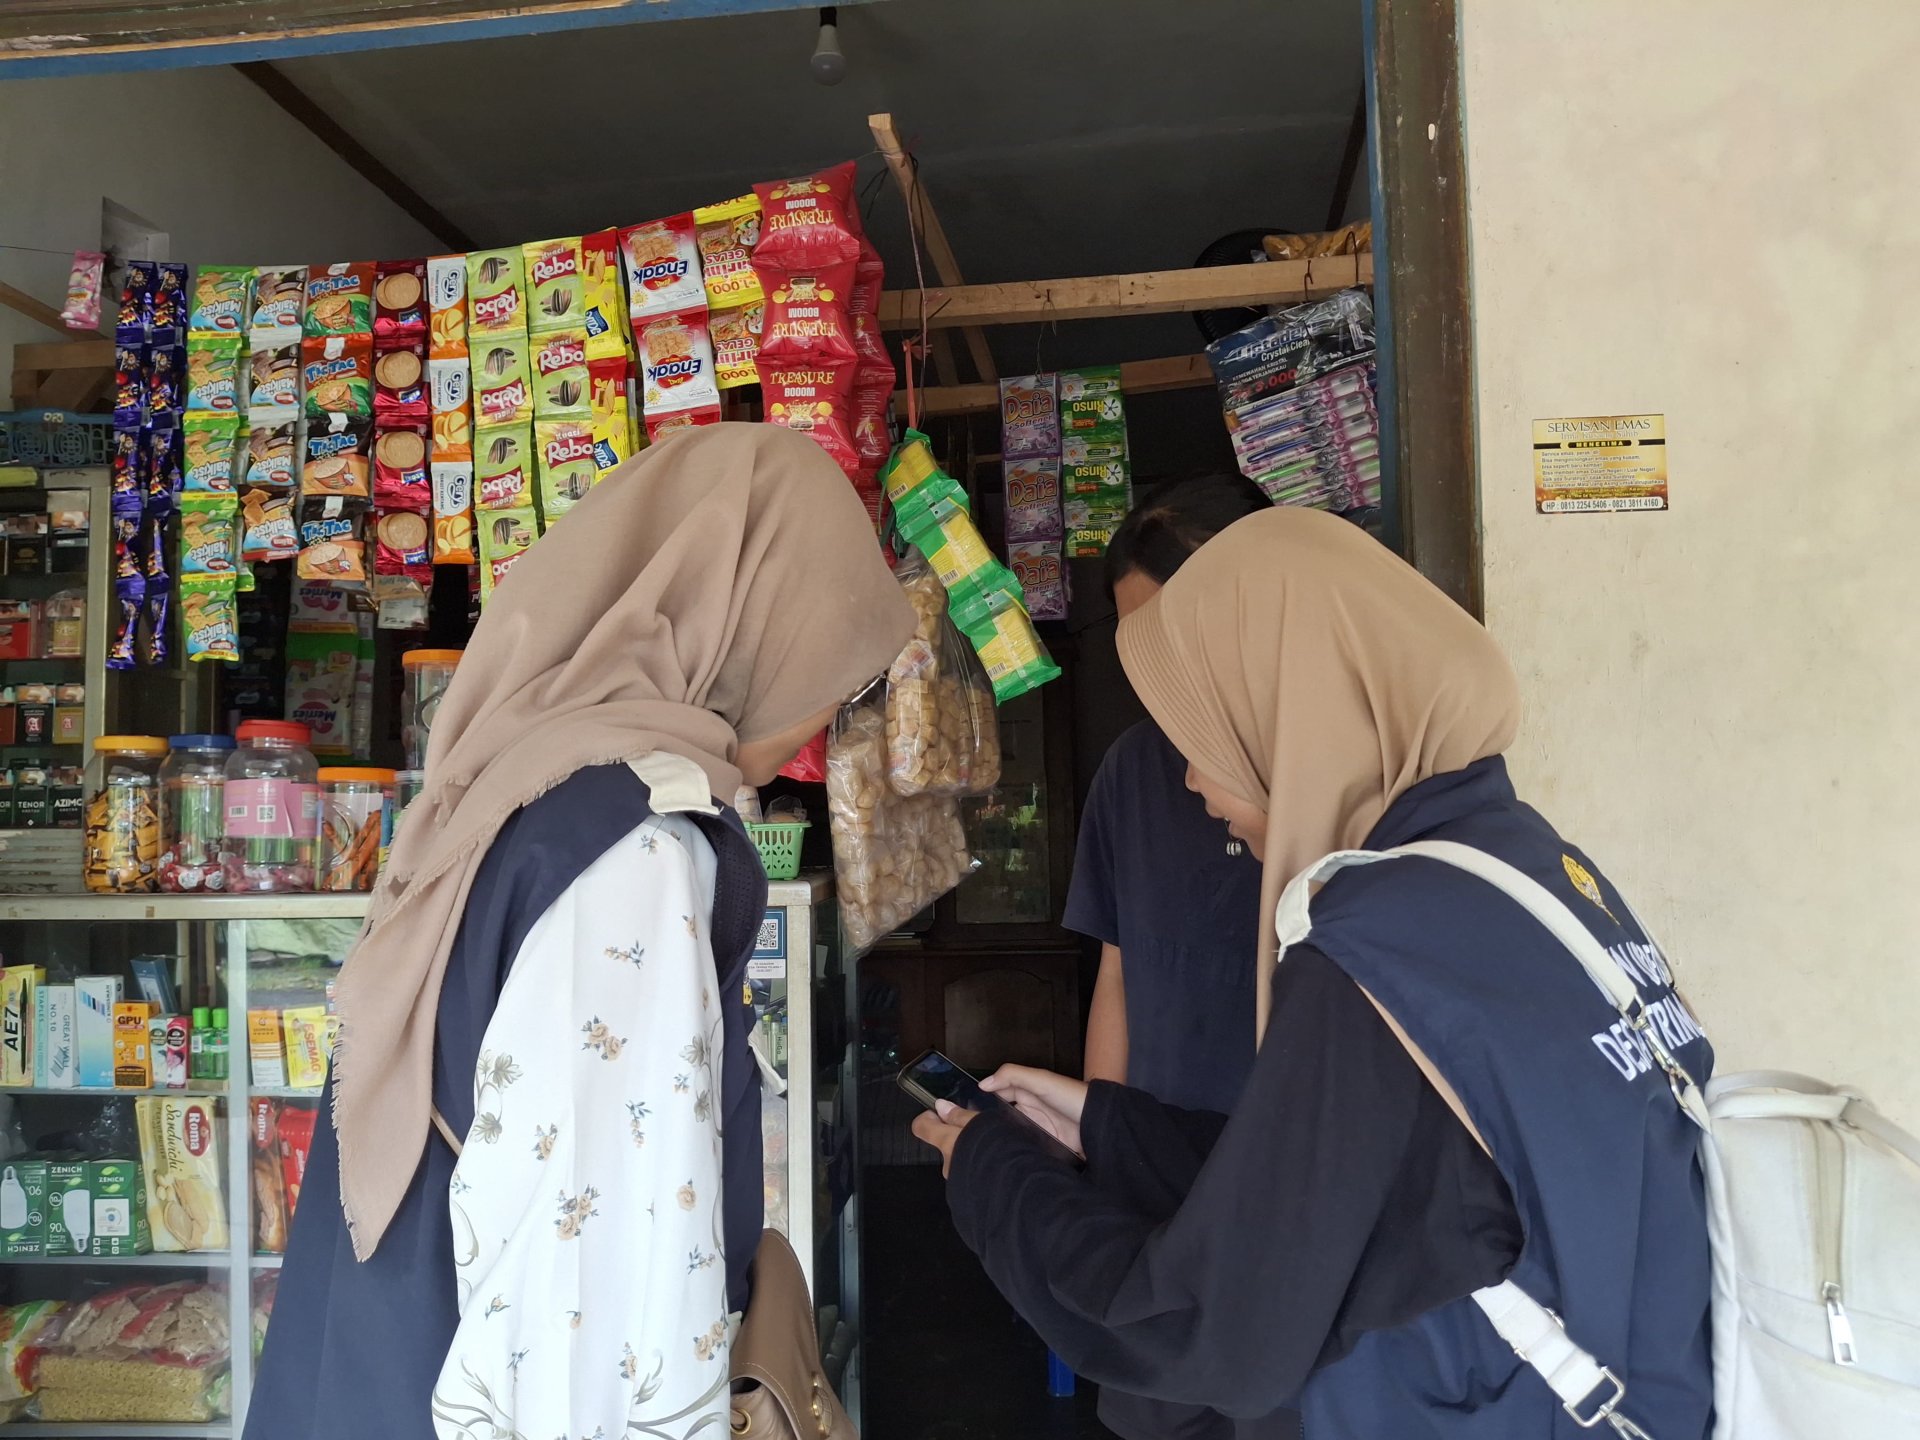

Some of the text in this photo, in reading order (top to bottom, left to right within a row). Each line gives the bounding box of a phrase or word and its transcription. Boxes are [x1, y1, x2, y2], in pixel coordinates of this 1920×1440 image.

[769, 209, 834, 231] TREASURE
[705, 250, 745, 263] GELAS
[532, 256, 575, 284] Rebo
[632, 260, 688, 284] Enaak
[442, 269, 460, 301] Gery
[712, 280, 750, 295] 1.000
[201, 300, 241, 317] Malkist
[263, 299, 299, 315] Malkist
[476, 289, 517, 318] Rebo
[772, 320, 836, 338] TREASURE
[716, 338, 754, 351] GELAS
[538, 348, 585, 372] Rebo
[647, 359, 703, 381] Enaak
[196, 379, 235, 398] Malkist
[260, 377, 296, 394] Malkist
[444, 371, 464, 404] Gery
[770, 371, 835, 386] TREASURE
[482, 384, 525, 409] Rebo
[784, 387, 815, 397] BOOOM
[1004, 392, 1054, 424] Daia
[1073, 400, 1104, 413] Rinso
[555, 429, 581, 441] Kuaci
[1547, 419, 1651, 433] SERVISAN EMAS
[545, 439, 593, 464] Rebo
[192, 460, 232, 479] Malkist
[256, 455, 291, 471] Malkist
[1075, 466, 1107, 478] Rinso
[447, 475, 467, 508] Gery
[482, 471, 522, 496] Rebo
[1008, 476, 1057, 507] Daia
[255, 516, 295, 538] Malkist
[1076, 530, 1109, 542] Rinso
[191, 540, 229, 561] Malkist
[1011, 558, 1060, 586] Daia
[300, 587, 342, 599] Merries
[193, 621, 232, 643] Malkist
[293, 709, 337, 722] Merries
[4, 1008, 19, 1052] AE7
[62, 1014, 70, 1044] GREAT
[118, 1016, 143, 1025] GPU
[304, 1023, 321, 1072] ESEMAG
[188, 1112, 200, 1150] Roma
[257, 1103, 268, 1141] Roma
[7, 1244, 40, 1252] ZENICH
